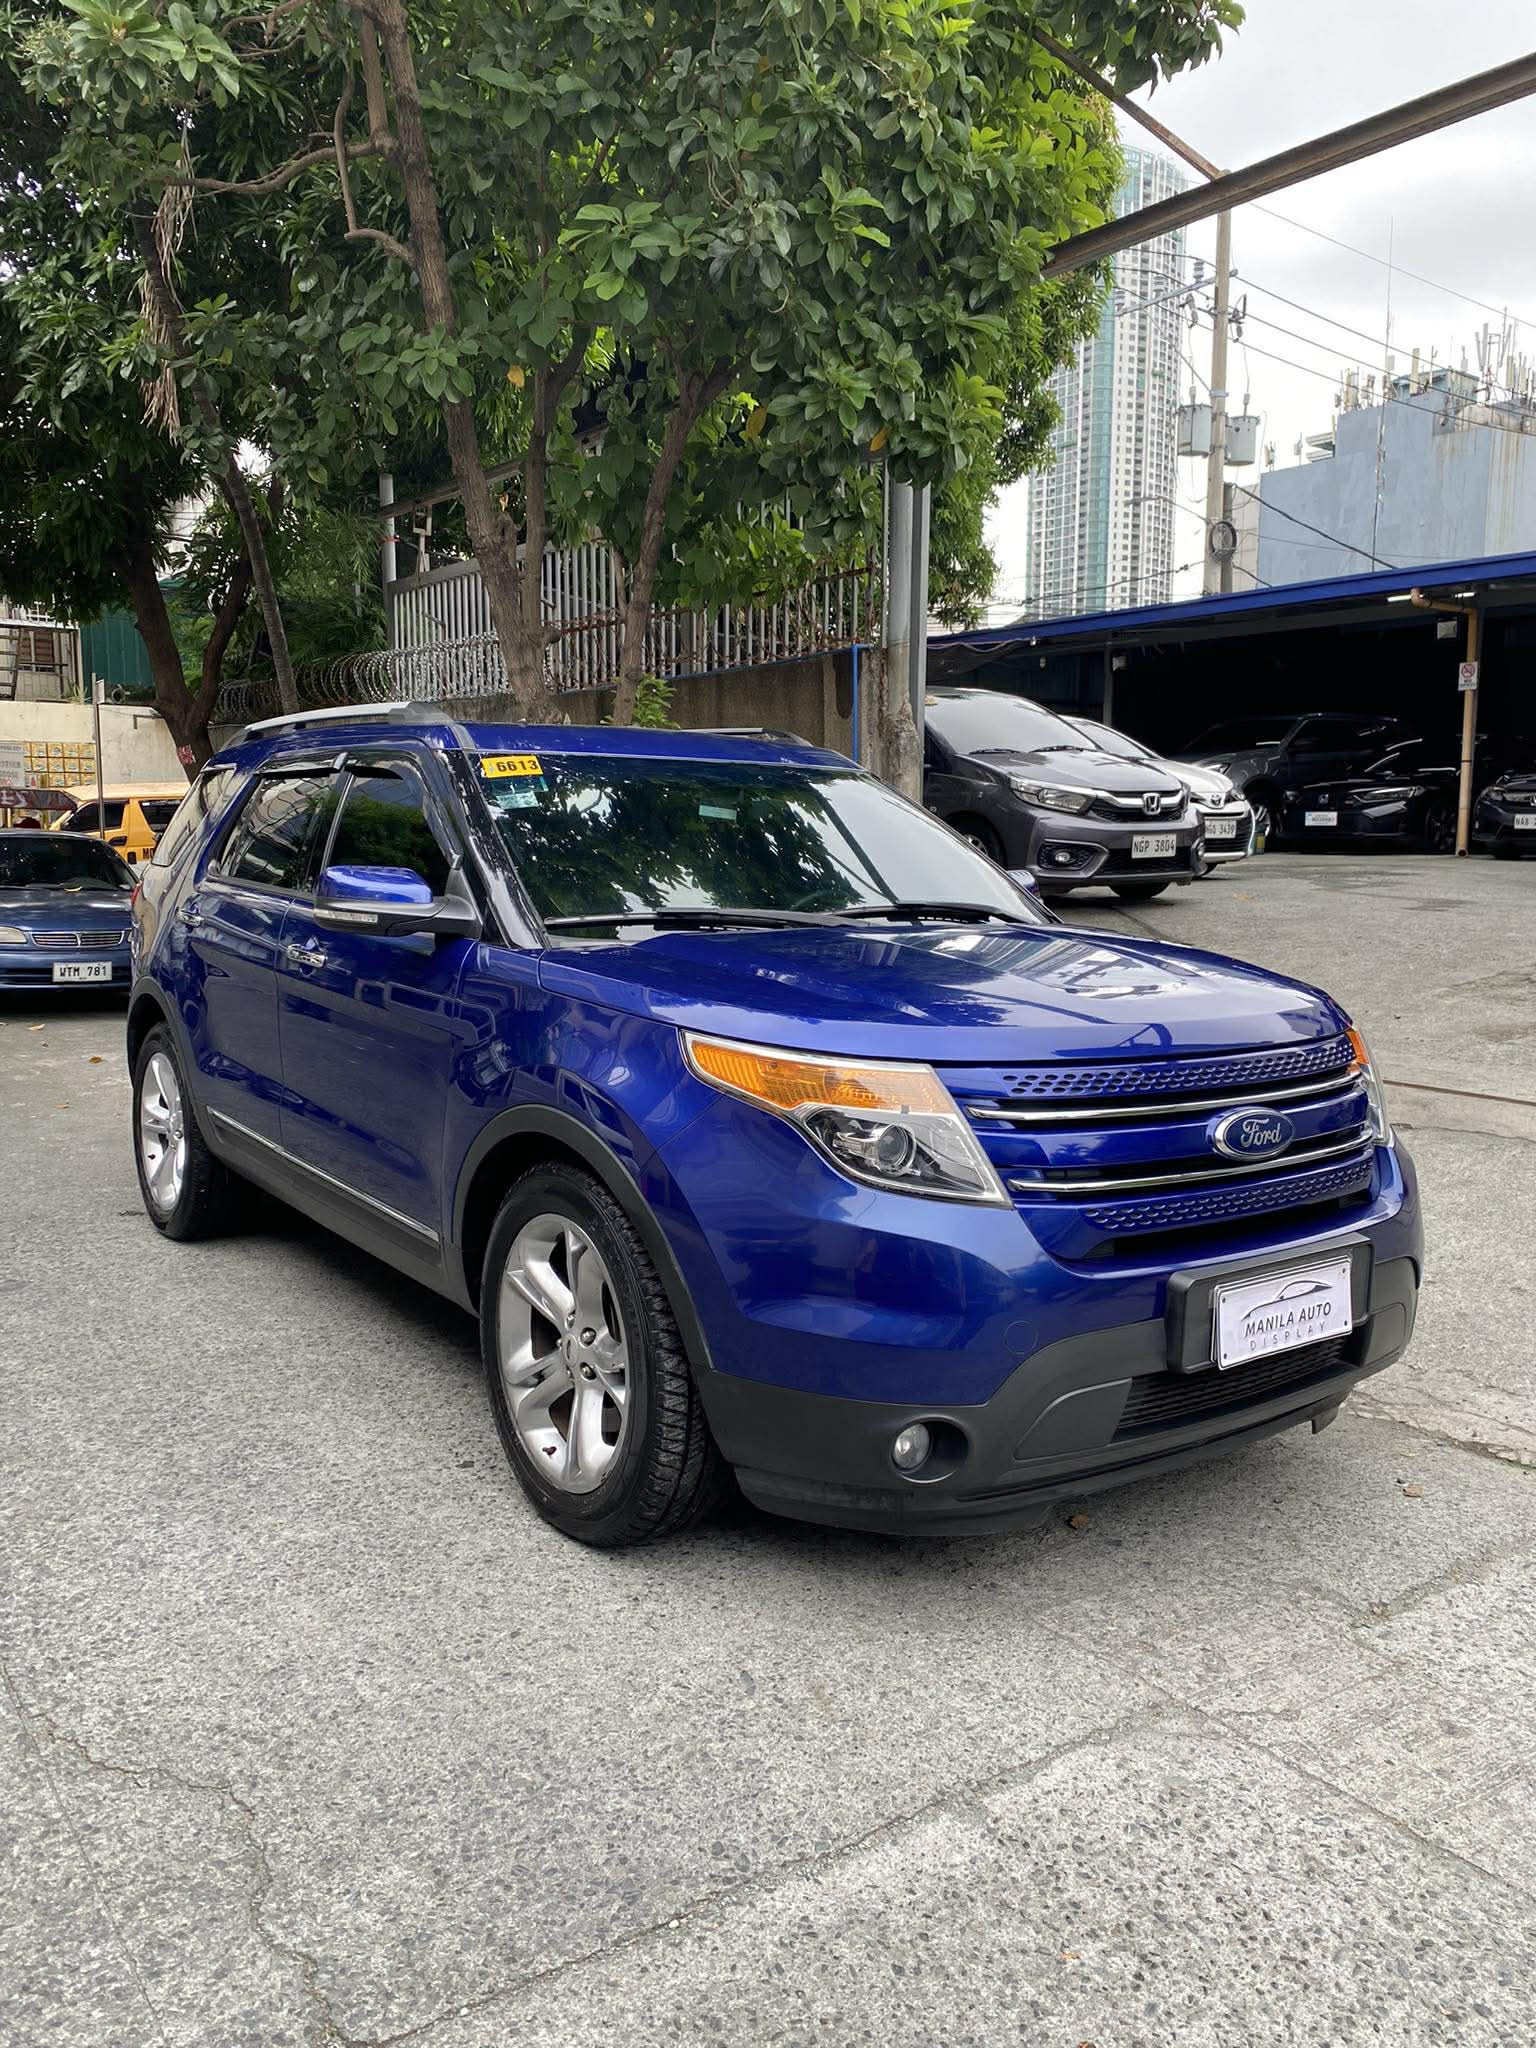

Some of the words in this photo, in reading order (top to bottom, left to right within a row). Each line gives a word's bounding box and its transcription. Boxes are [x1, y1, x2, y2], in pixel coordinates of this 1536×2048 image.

[496, 760, 538, 772] 6613
[1133, 840, 1150, 852] NGP
[60, 966, 80, 977] WTM
[87, 966, 106, 977] 781
[1241, 1118, 1281, 1148] Ford
[1245, 1311, 1295, 1338] MANILA
[1299, 1302, 1332, 1322] AUTO
